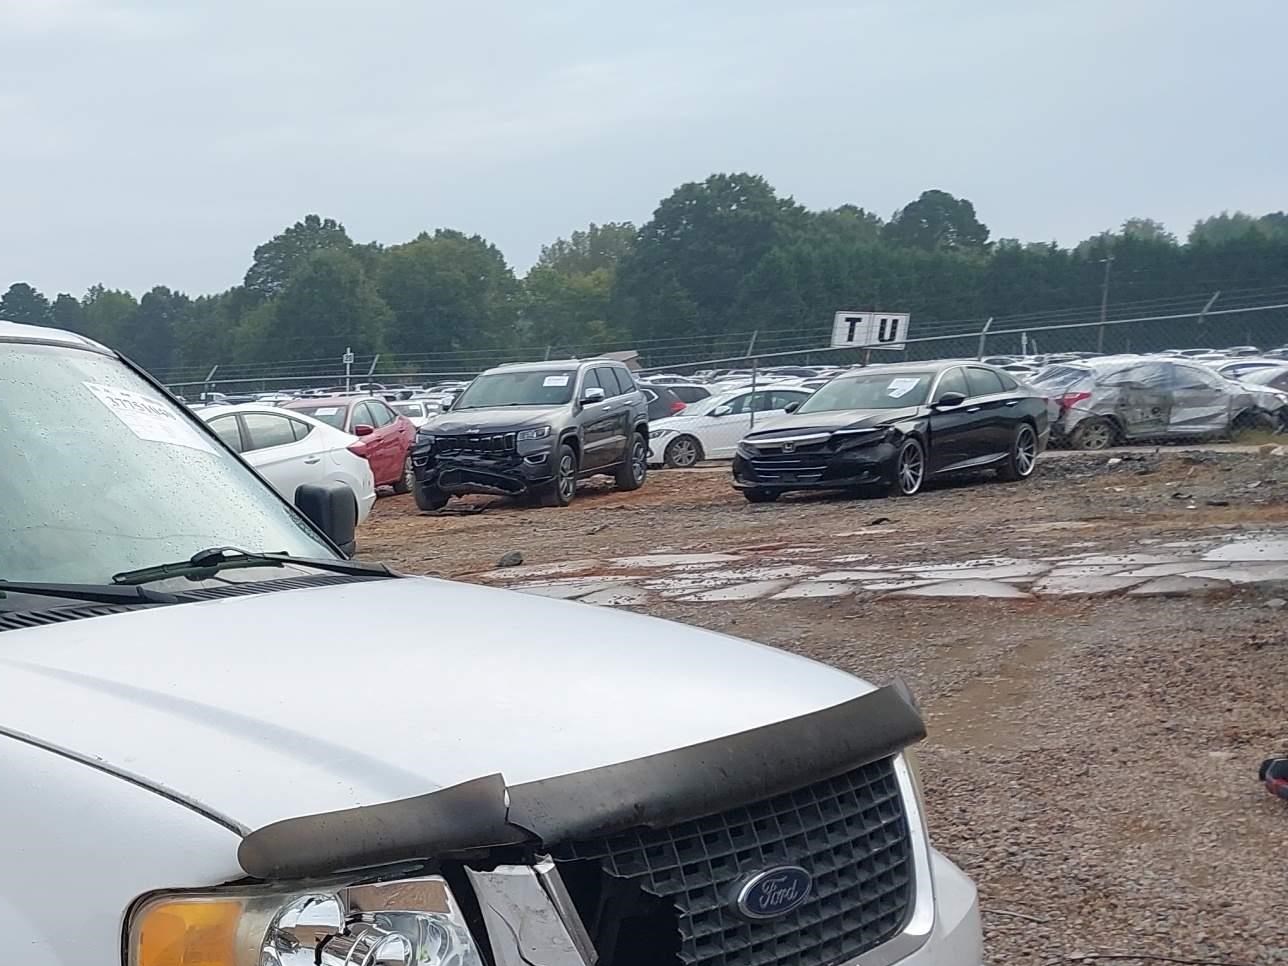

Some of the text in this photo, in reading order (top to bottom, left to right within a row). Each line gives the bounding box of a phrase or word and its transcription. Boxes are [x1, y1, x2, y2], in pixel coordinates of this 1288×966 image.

[844, 317, 899, 342] T U
[759, 875, 798, 909] Ford
